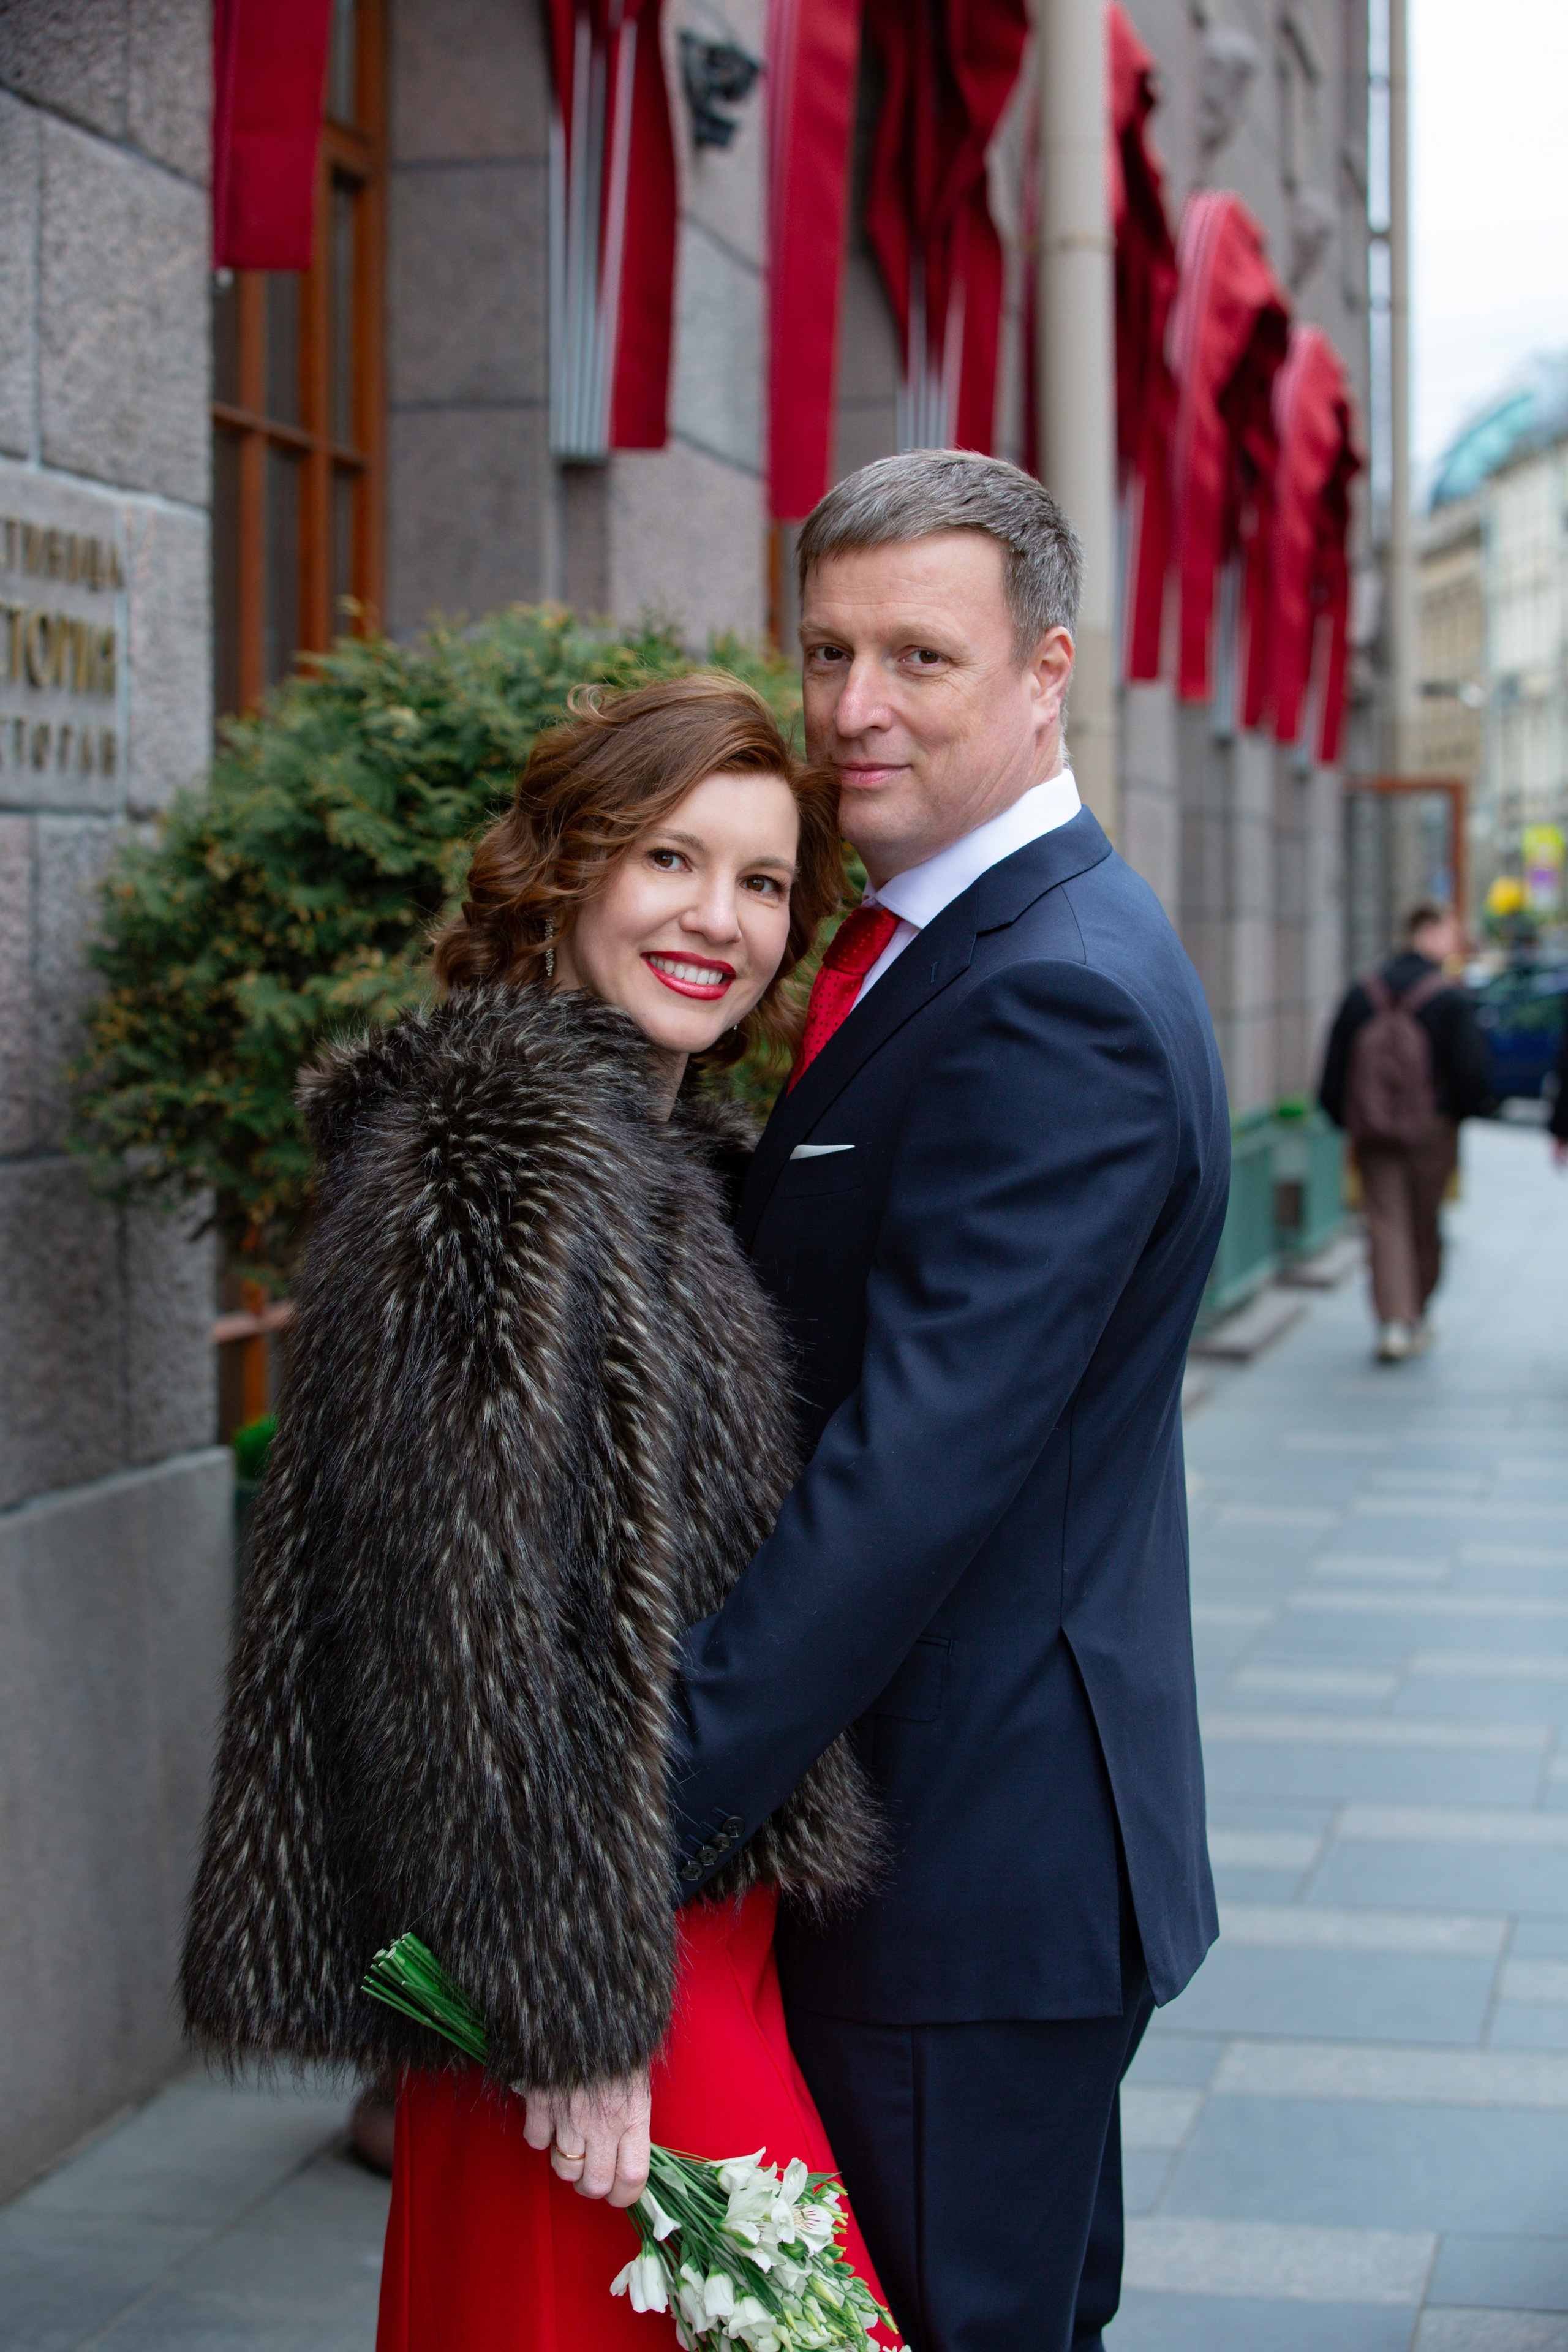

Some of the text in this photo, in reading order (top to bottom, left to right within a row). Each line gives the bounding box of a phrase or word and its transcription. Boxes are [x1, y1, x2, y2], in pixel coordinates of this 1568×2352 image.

[0, 513, 124, 592] ТИНИЦА
[0, 600, 117, 698] ТОРИЯ
[0, 715, 116, 778] ТОРАН
